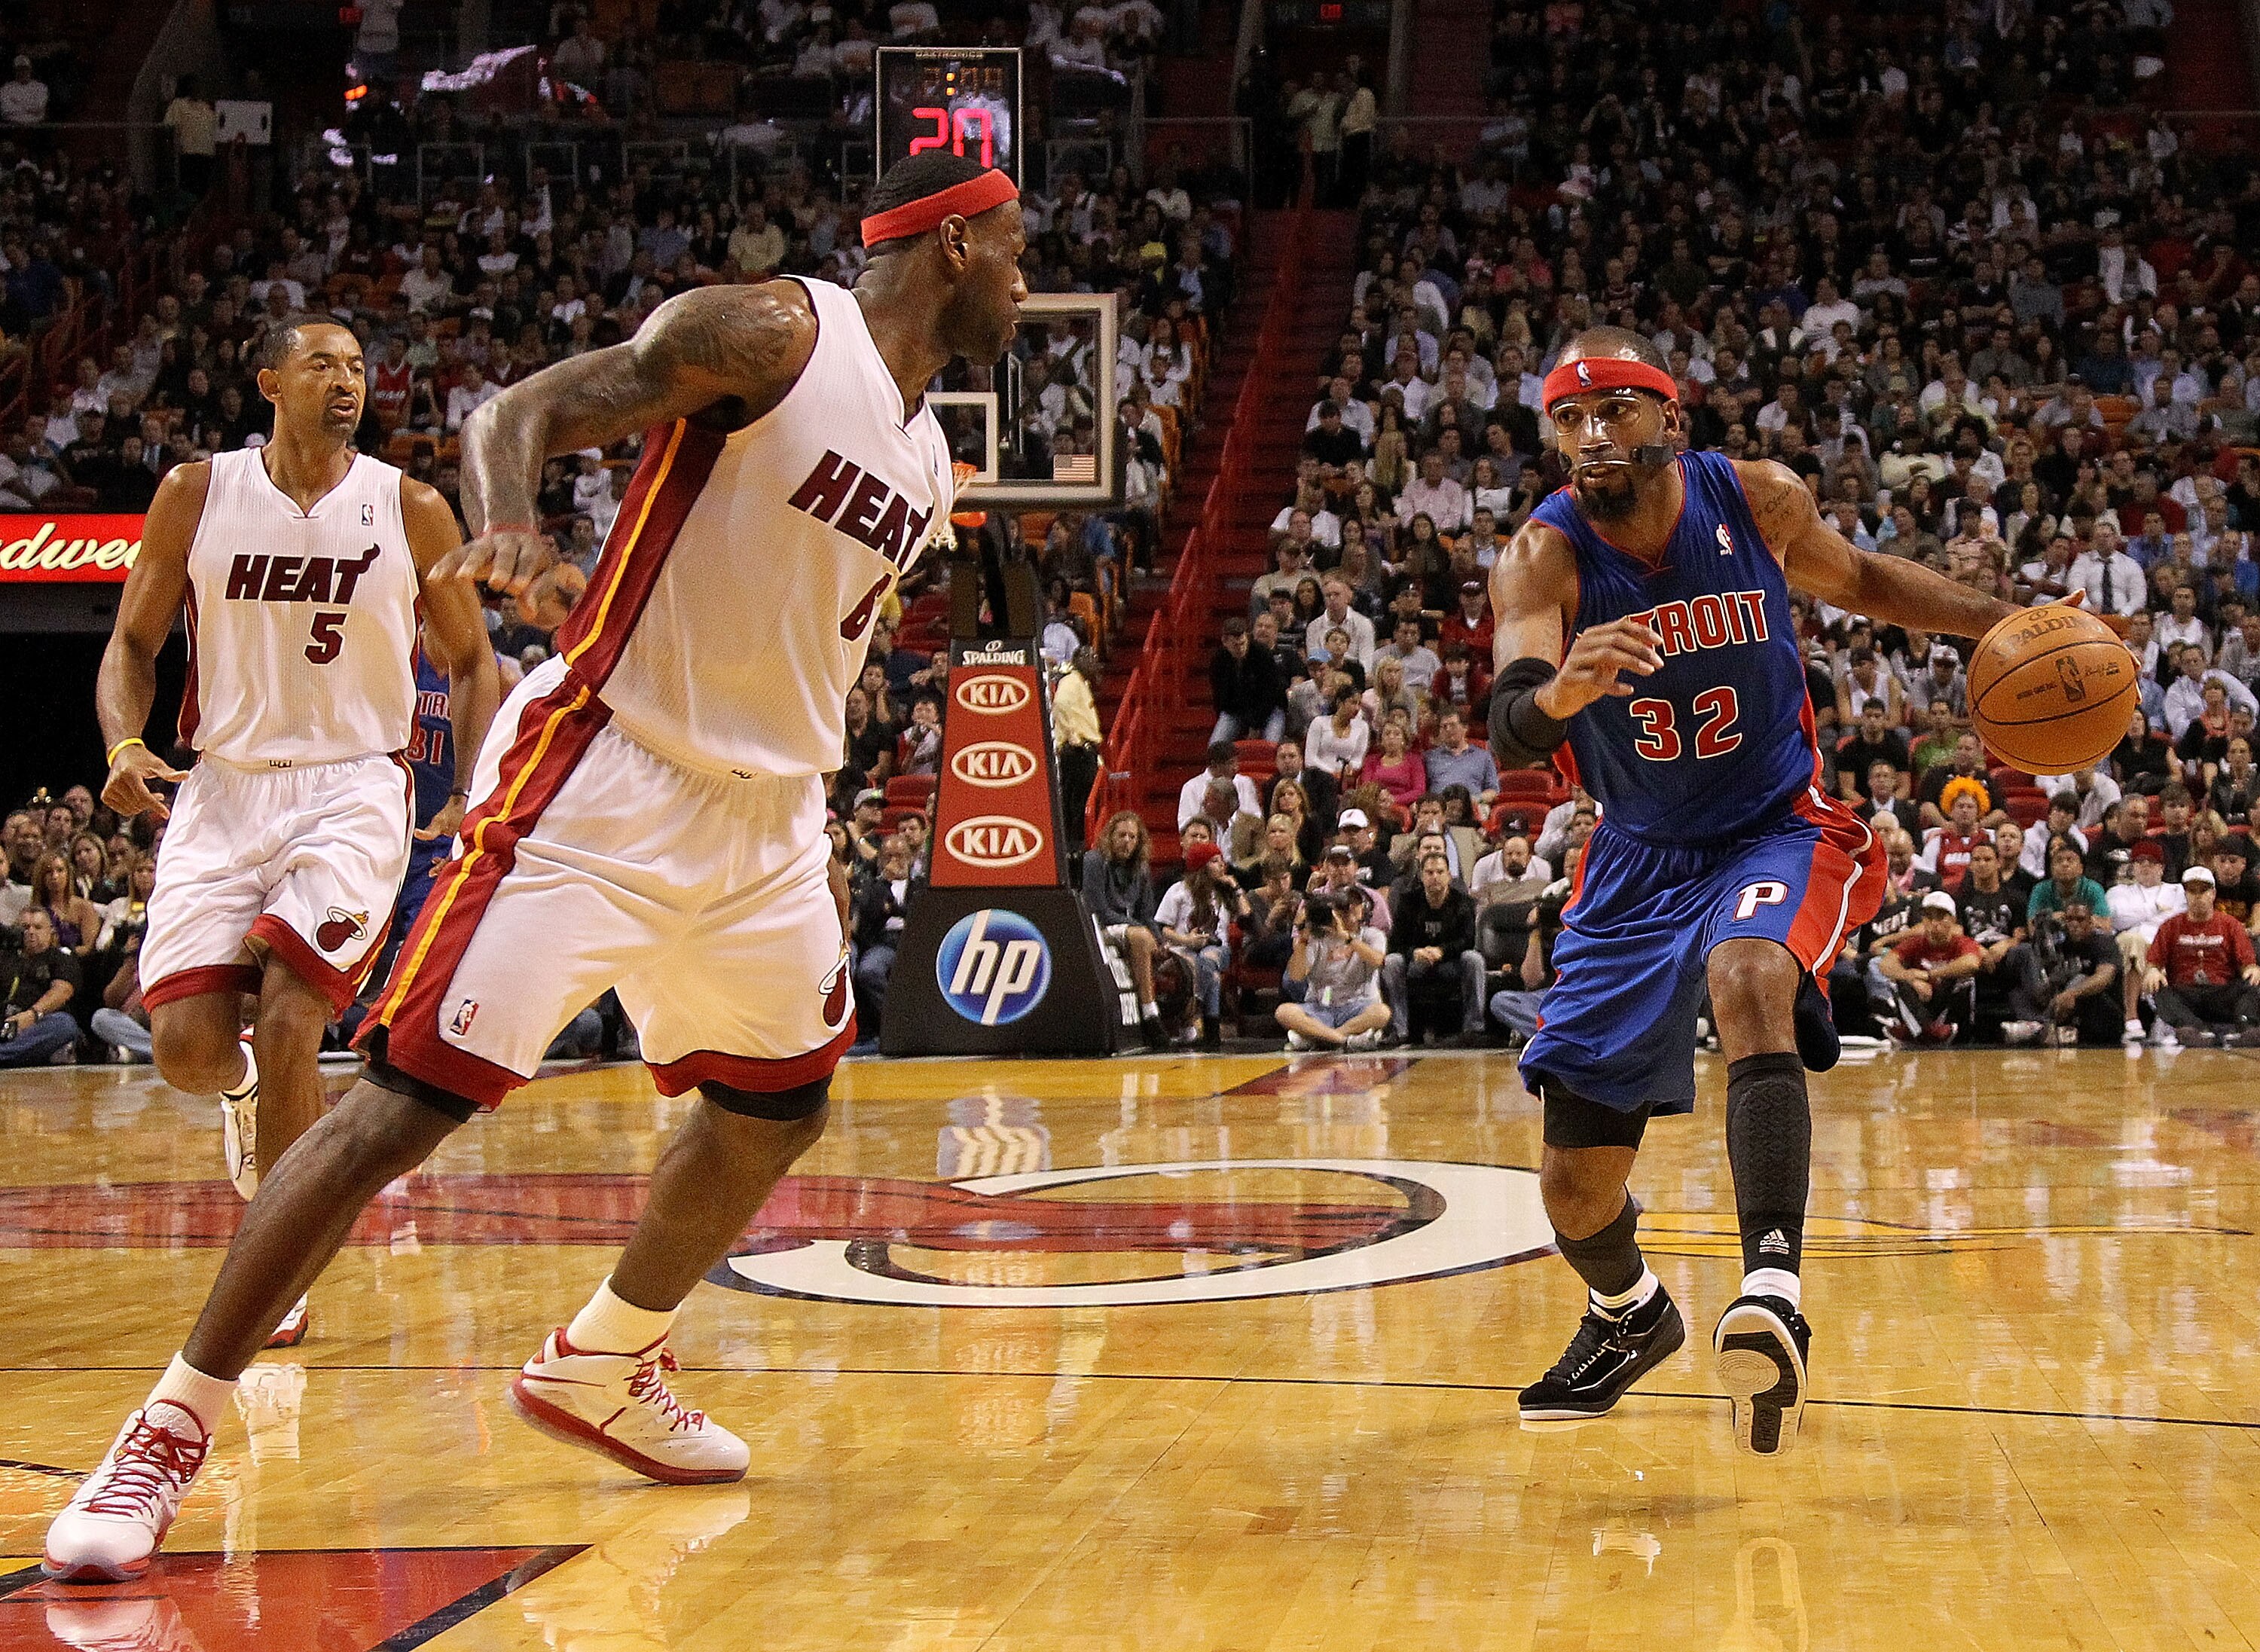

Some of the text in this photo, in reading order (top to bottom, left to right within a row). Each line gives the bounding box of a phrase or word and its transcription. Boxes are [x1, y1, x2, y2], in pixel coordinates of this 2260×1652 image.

[787, 449, 934, 573] HEAT
[225, 542, 380, 605] HEAT
[304, 612, 347, 665] 5
[1626, 589, 1769, 656] TROIT
[963, 649, 1025, 665] SPALDING
[970, 683, 1022, 706] KIA
[1629, 686, 1742, 761] 32
[967, 752, 1023, 777] KIA
[963, 828, 1028, 856] KIA
[1733, 880, 1790, 921] P
[949, 908, 1041, 1026] hp
